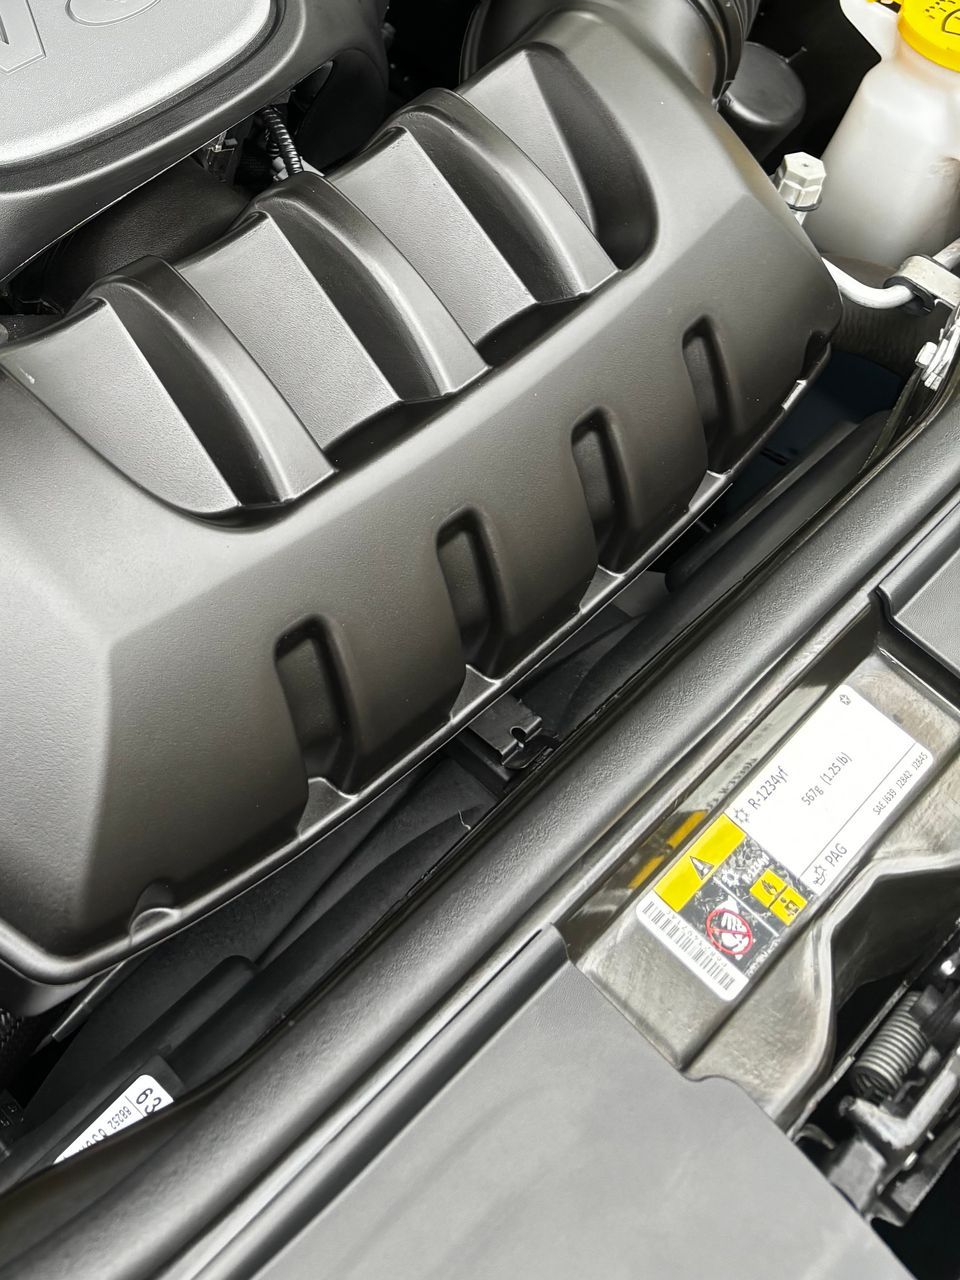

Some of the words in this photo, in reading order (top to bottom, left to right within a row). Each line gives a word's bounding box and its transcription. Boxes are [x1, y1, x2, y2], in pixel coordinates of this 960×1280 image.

[747, 765, 789, 810] R-1234yf
[801, 785, 824, 806] 567g
[820, 762, 841, 786] (1.25
[836, 751, 853, 766] lb)
[872, 801, 887, 816] SAE
[825, 843, 848, 867] PAG
